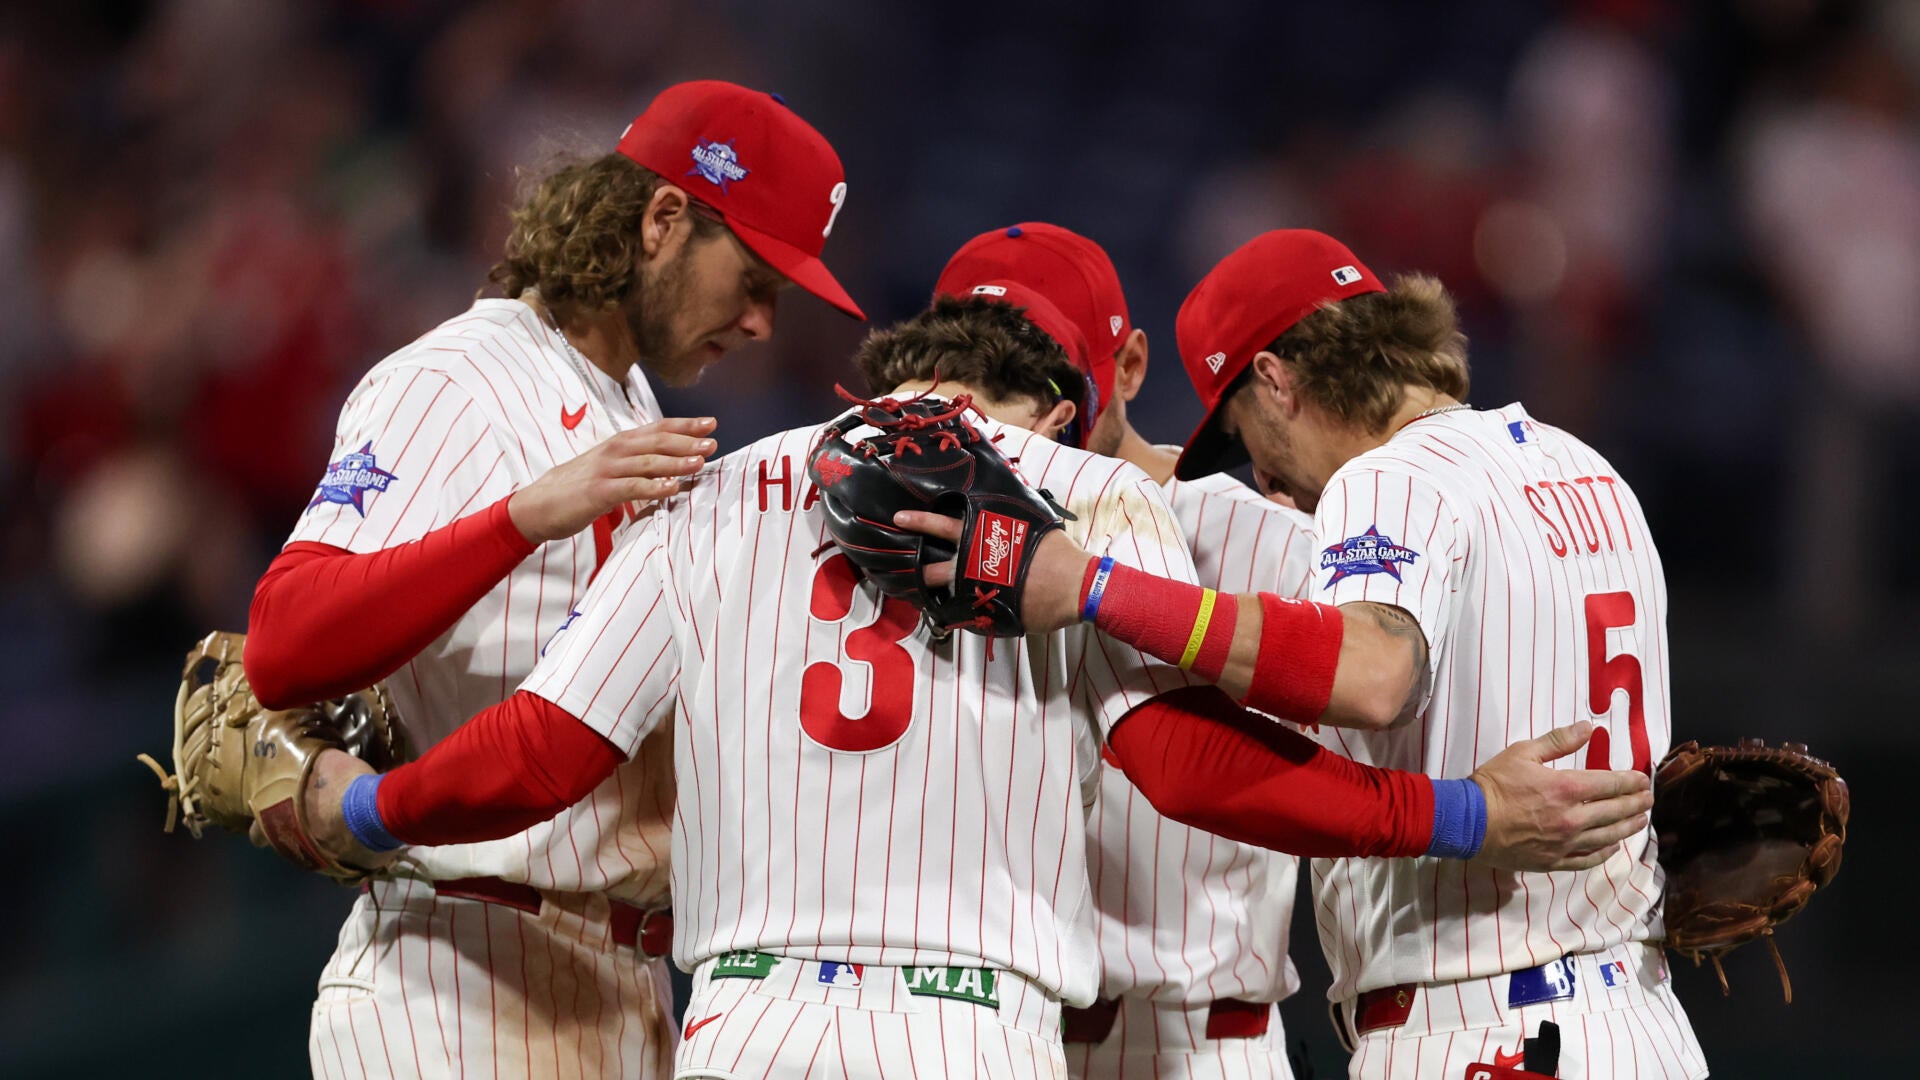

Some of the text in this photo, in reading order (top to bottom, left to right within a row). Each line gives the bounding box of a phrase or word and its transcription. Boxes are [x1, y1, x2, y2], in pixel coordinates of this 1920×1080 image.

[356, 468, 389, 489] GAME
[982, 519, 1009, 577] Rawlings
[1523, 475, 1633, 559] STOTT
[1321, 551, 1345, 566] ALL
[1346, 547, 1378, 562] STAR
[1378, 546, 1413, 561] GAME
[799, 547, 922, 755] 3
[1583, 590, 1652, 771] 5
